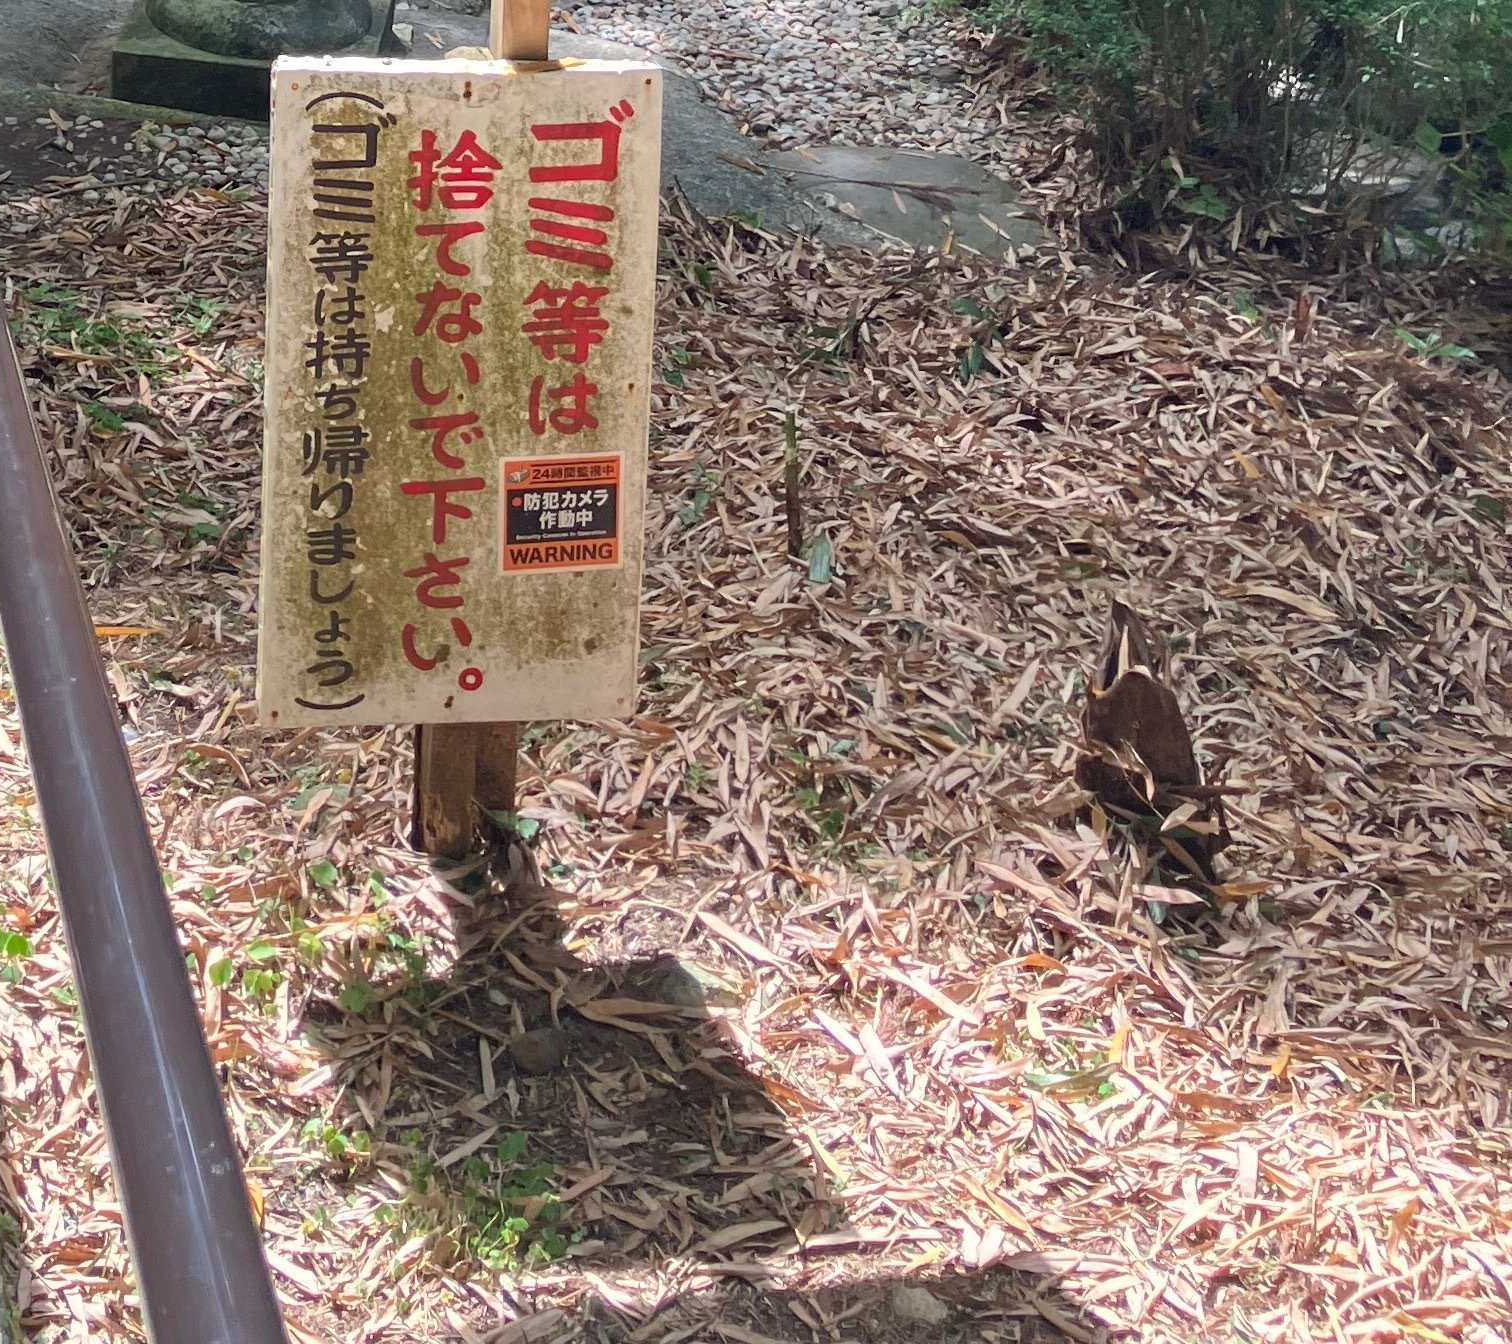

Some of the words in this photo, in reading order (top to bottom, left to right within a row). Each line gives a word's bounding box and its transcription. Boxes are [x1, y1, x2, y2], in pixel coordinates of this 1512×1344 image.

[521, 99, 636, 437] ゴミ等は
[295, 91, 397, 710] （ゴミ等は持ち帰りましょう）
[400, 128, 504, 693] 捨てないで下さい。
[509, 542, 613, 566] WARNING
[523, 489, 609, 511] 防犯カメラ
[539, 508, 593, 530] 作動中
